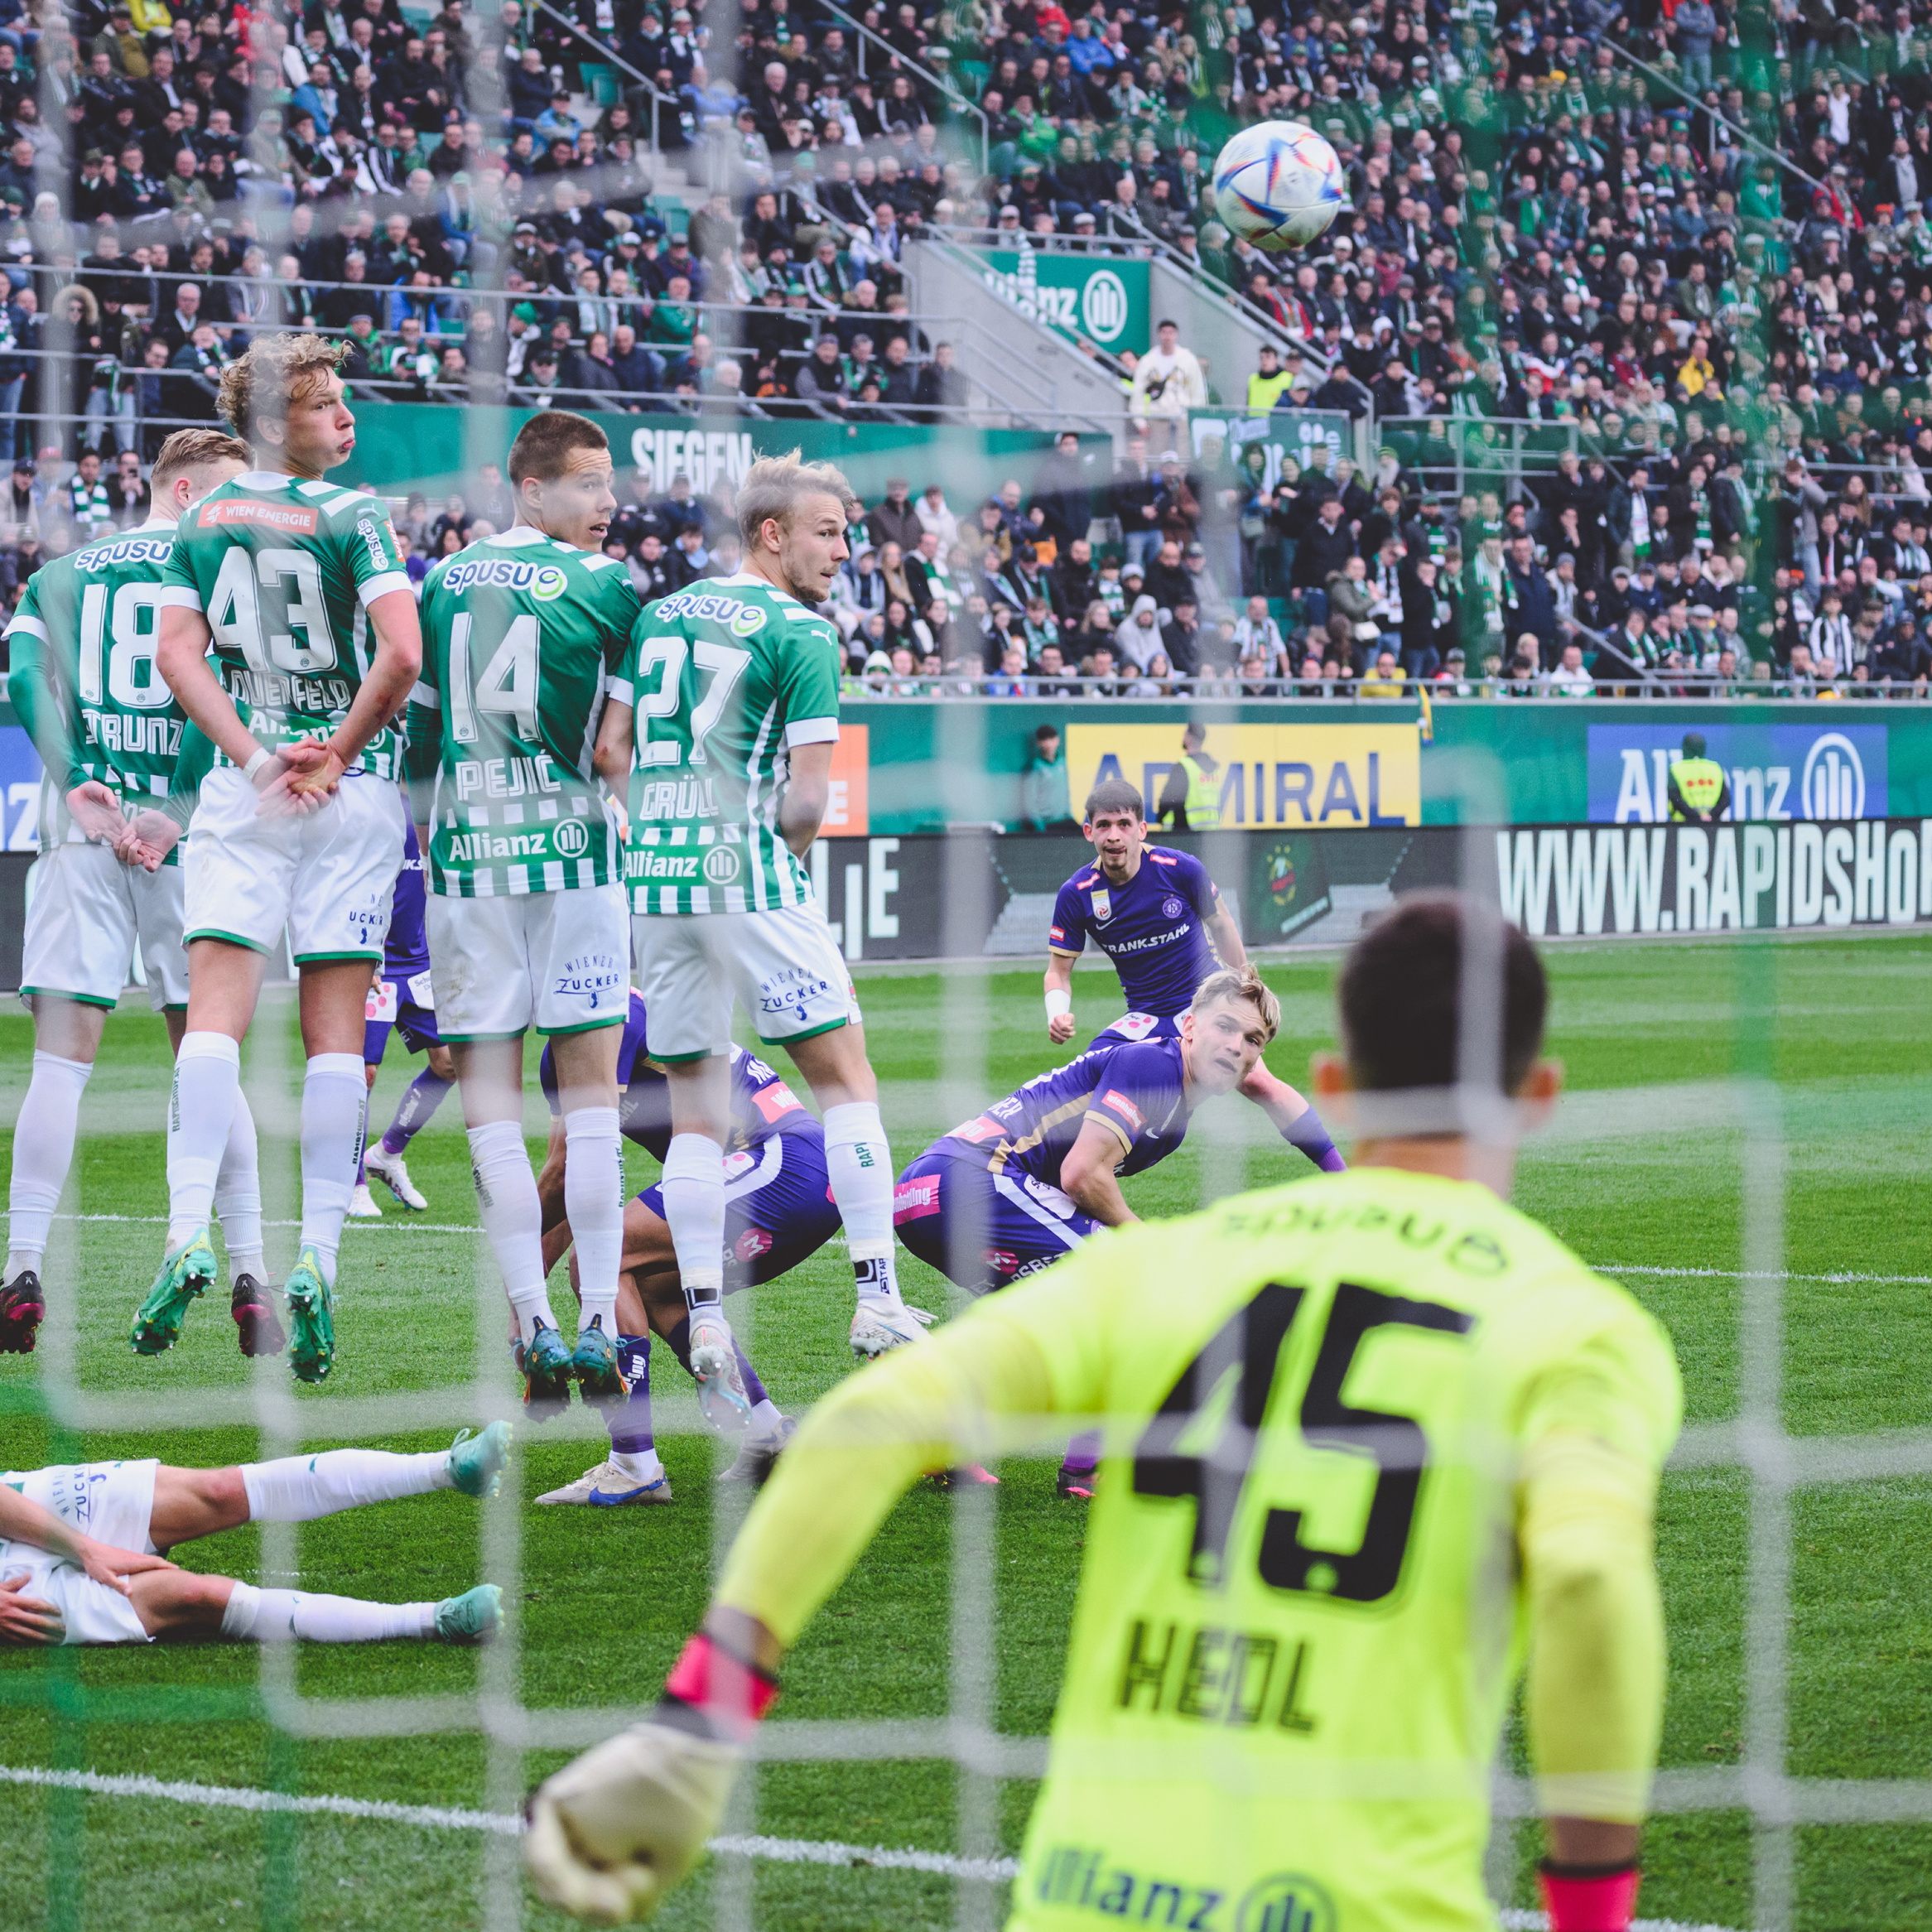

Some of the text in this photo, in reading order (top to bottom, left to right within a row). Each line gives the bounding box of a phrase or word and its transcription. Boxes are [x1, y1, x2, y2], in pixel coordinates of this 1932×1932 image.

[226, 505, 311, 528] WIEN ENERGIE
[76, 540, 172, 572] spusu
[445, 560, 534, 595] spusu
[207, 547, 339, 674] 43
[657, 594, 742, 622] spusu
[79, 581, 176, 708] 18
[449, 611, 543, 744] 14
[637, 636, 753, 769] 27
[455, 749, 562, 801] PEJIĆ
[639, 774, 720, 820] GRÜLL
[448, 832, 547, 862] Allianz
[624, 850, 698, 878] Allianz
[564, 955, 614, 973] WIENER
[555, 974, 619, 995] ZUCKER
[759, 980, 831, 1013] ZUCKER
[1134, 1282, 1478, 1603] 45
